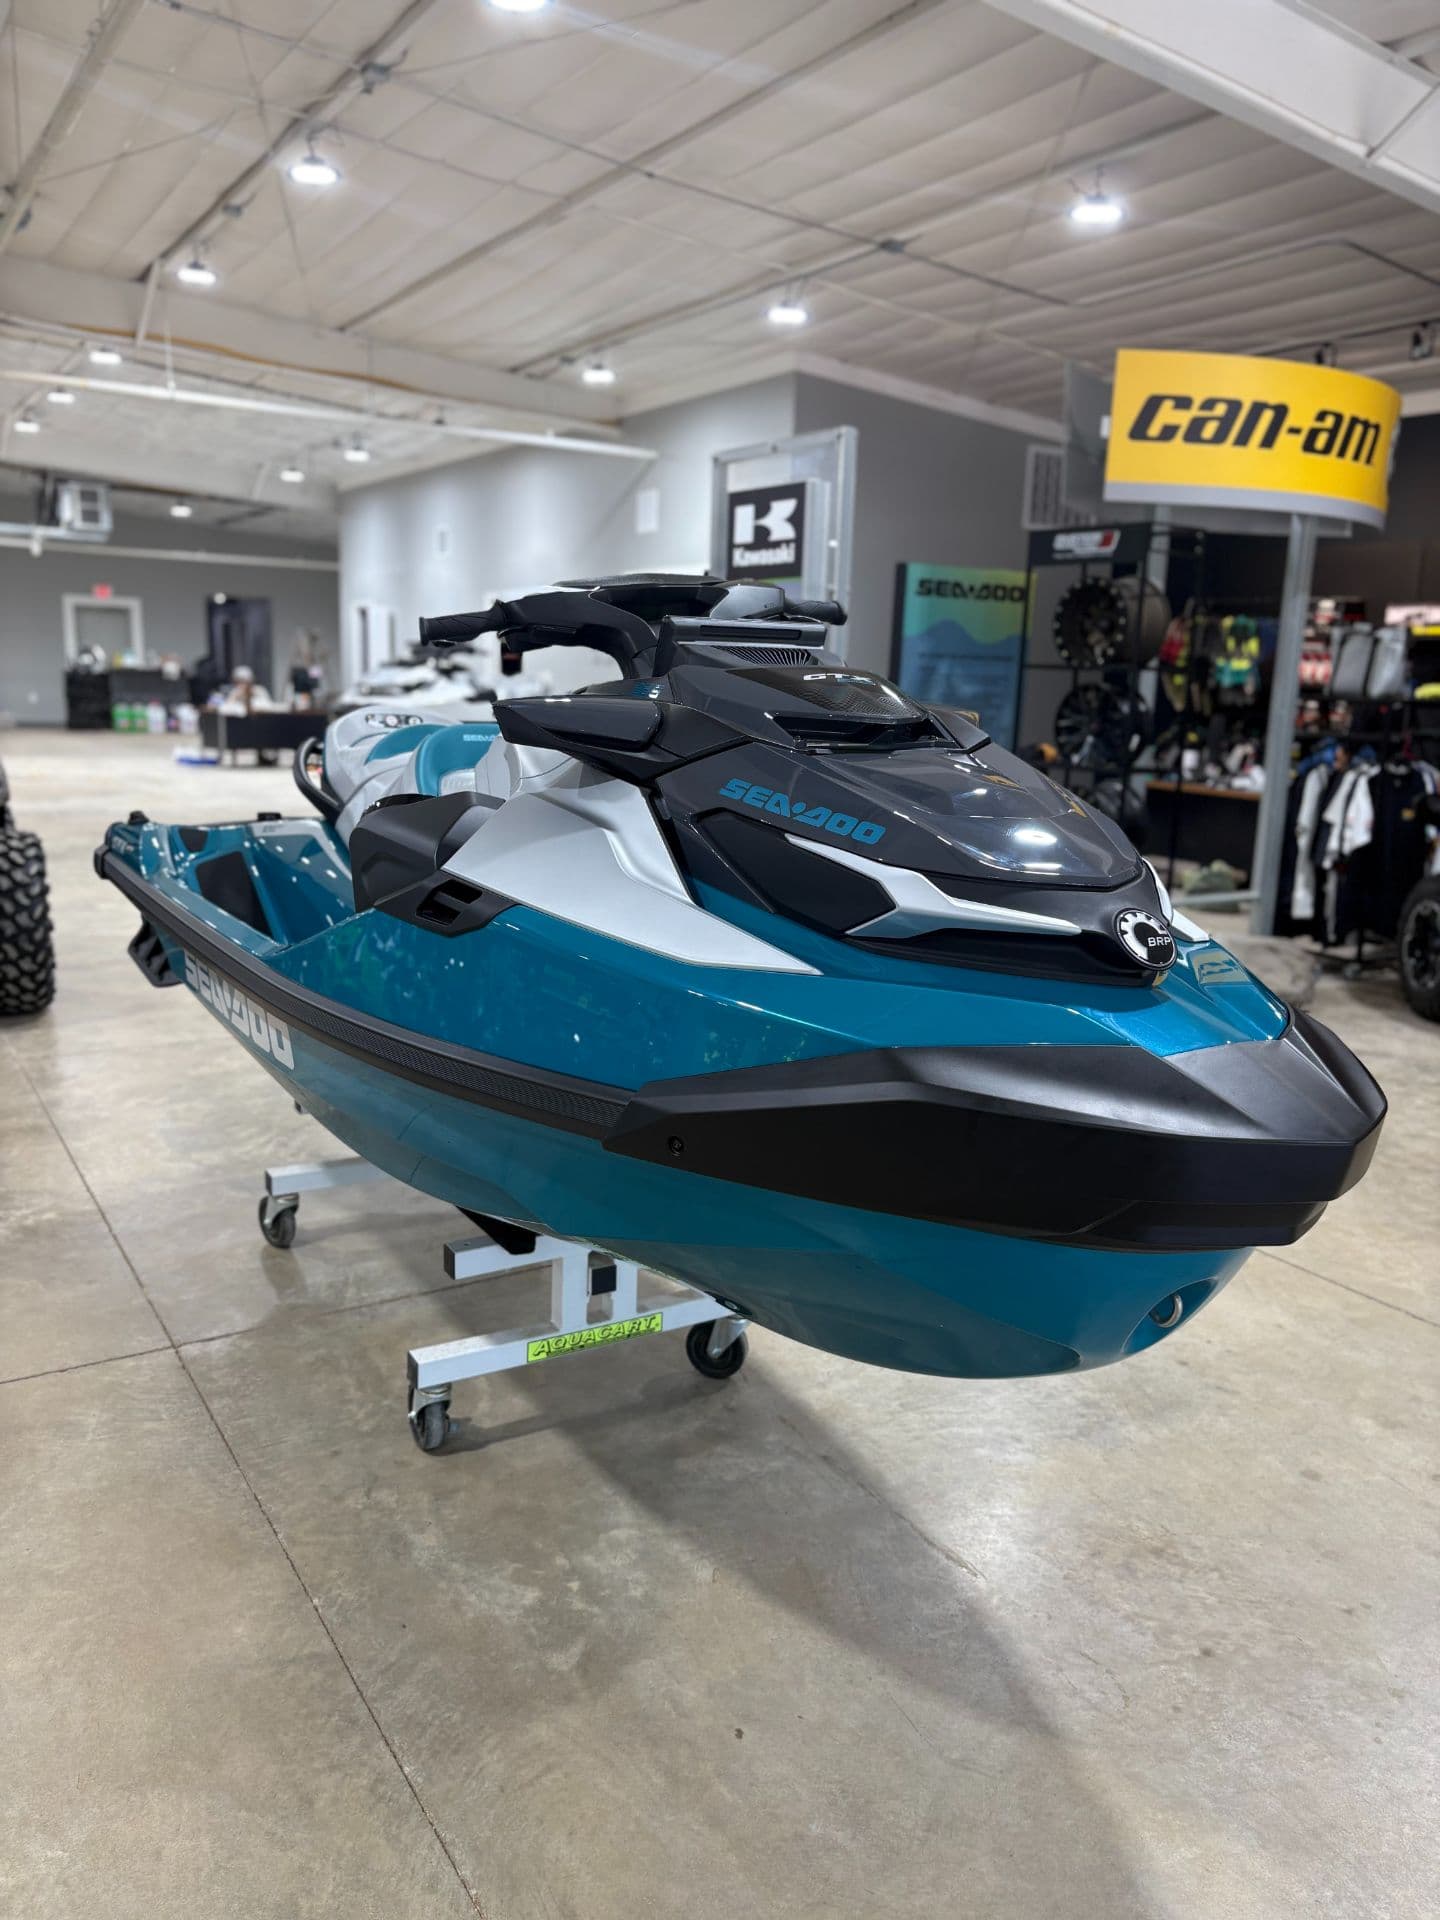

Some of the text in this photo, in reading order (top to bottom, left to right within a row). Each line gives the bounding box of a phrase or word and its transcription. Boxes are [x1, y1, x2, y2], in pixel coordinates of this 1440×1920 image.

[1128, 394, 1381, 466] can-am
[1147, 936, 1172, 948] BRP
[533, 1315, 657, 1357] AQUACART
